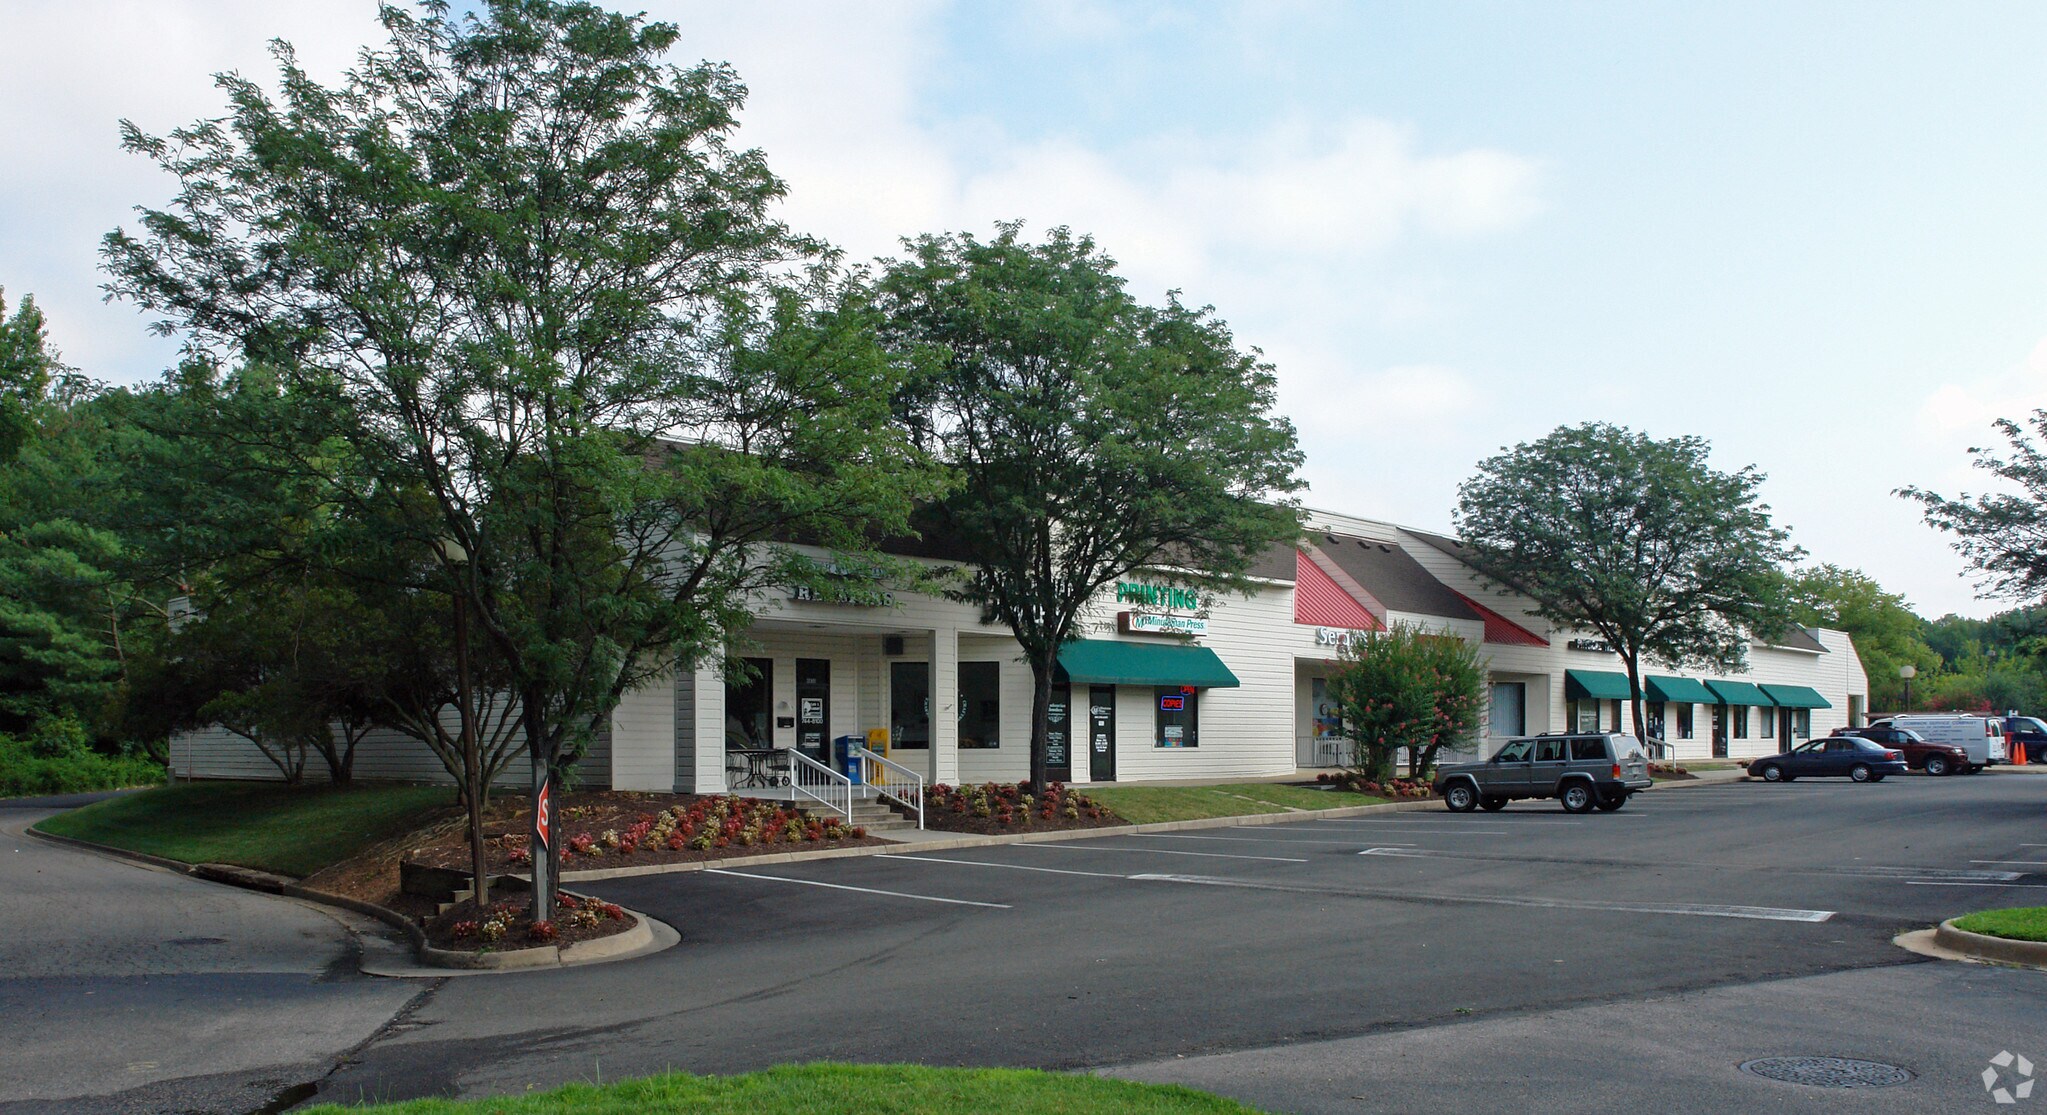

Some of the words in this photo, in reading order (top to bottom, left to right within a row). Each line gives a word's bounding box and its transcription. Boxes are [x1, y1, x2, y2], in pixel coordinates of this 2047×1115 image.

[1117, 582, 1197, 610] PRINTING
[1187, 618, 1204, 629] Press
[1163, 699, 1182, 708] COPIES
